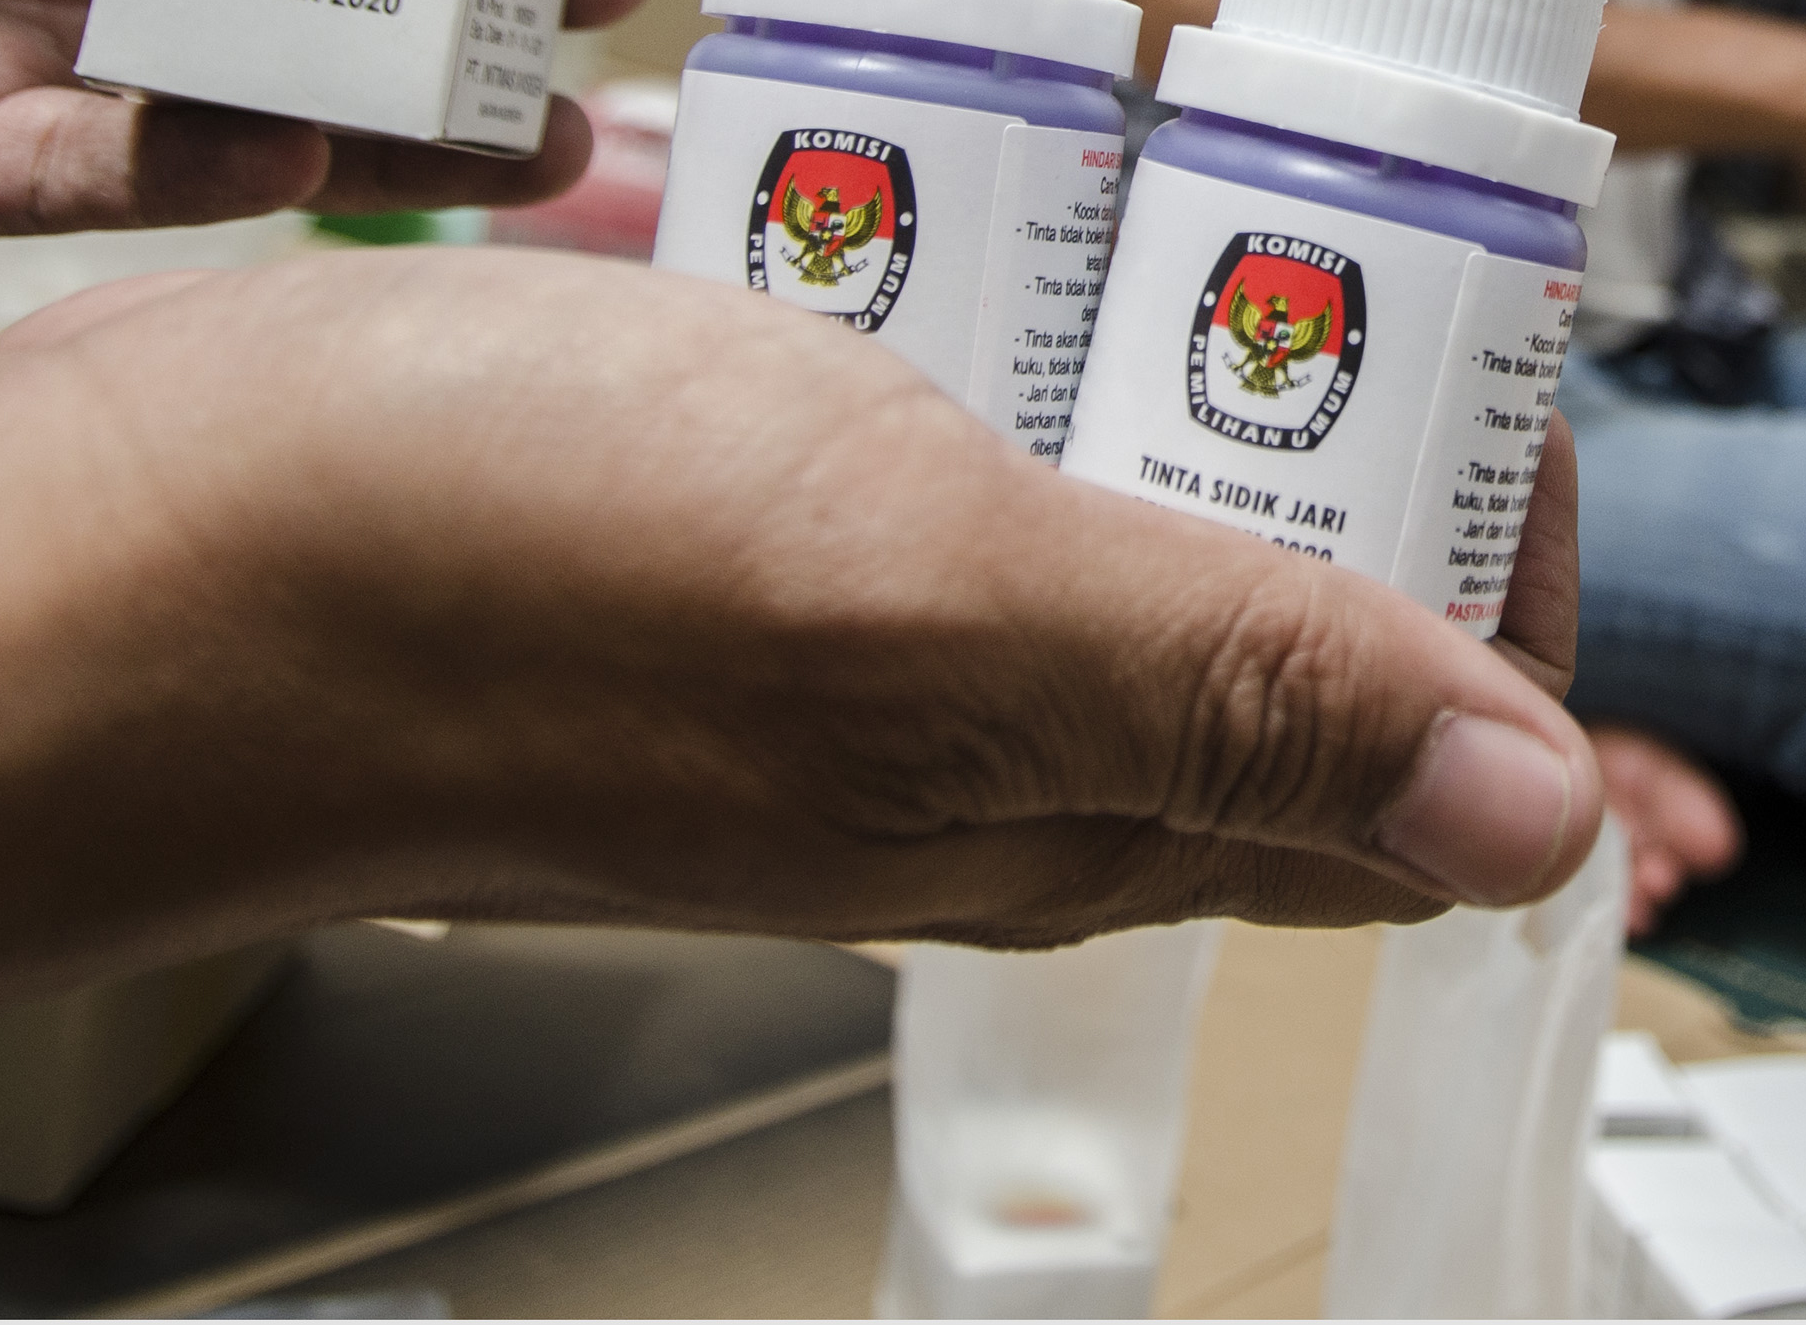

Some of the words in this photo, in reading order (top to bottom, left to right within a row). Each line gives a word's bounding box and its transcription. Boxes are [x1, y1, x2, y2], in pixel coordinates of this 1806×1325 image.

[794, 130, 891, 163] KOMISI
[1073, 201, 1100, 221] Kocok
[1026, 221, 1056, 243] Tinta
[1060, 225, 1083, 244] tidak
[1247, 233, 1348, 276] KOMISI
[855, 252, 909, 331] UMUM
[1035, 276, 1062, 296] Tinta
[1065, 278, 1086, 297] tidak
[1087, 280, 1102, 297] bole
[1024, 329, 1053, 348] Tinta
[1055, 331, 1078, 349] akan
[1530, 333, 1555, 352] Kocok
[1013, 356, 1045, 377] kuku,
[1049, 357, 1070, 376] tidak
[1482, 350, 1512, 374] Tinta
[1514, 356, 1537, 377] tidak
[1026, 383, 1048, 403] Jari
[1051, 385, 1068, 403] dan
[1189, 333, 1283, 447] PEMILIHAN
[1291, 369, 1353, 448] UMUM
[1016, 411, 1056, 430] biarkan
[1484, 408, 1511, 430] Tinta
[1513, 412, 1533, 432] tidak
[1468, 462, 1496, 483] Tinta
[1497, 466, 1520, 485] akan
[1140, 454, 1201, 498] TINTA
[1210, 479, 1280, 519] SIDIK
[1285, 500, 1348, 535] JARI
[1452, 490, 1484, 514] kuku,
[1487, 494, 1509, 512] tidak
[1462, 520, 1485, 540] Jari
[1486, 522, 1503, 541] dan
[1448, 547, 1489, 568] biarkan
